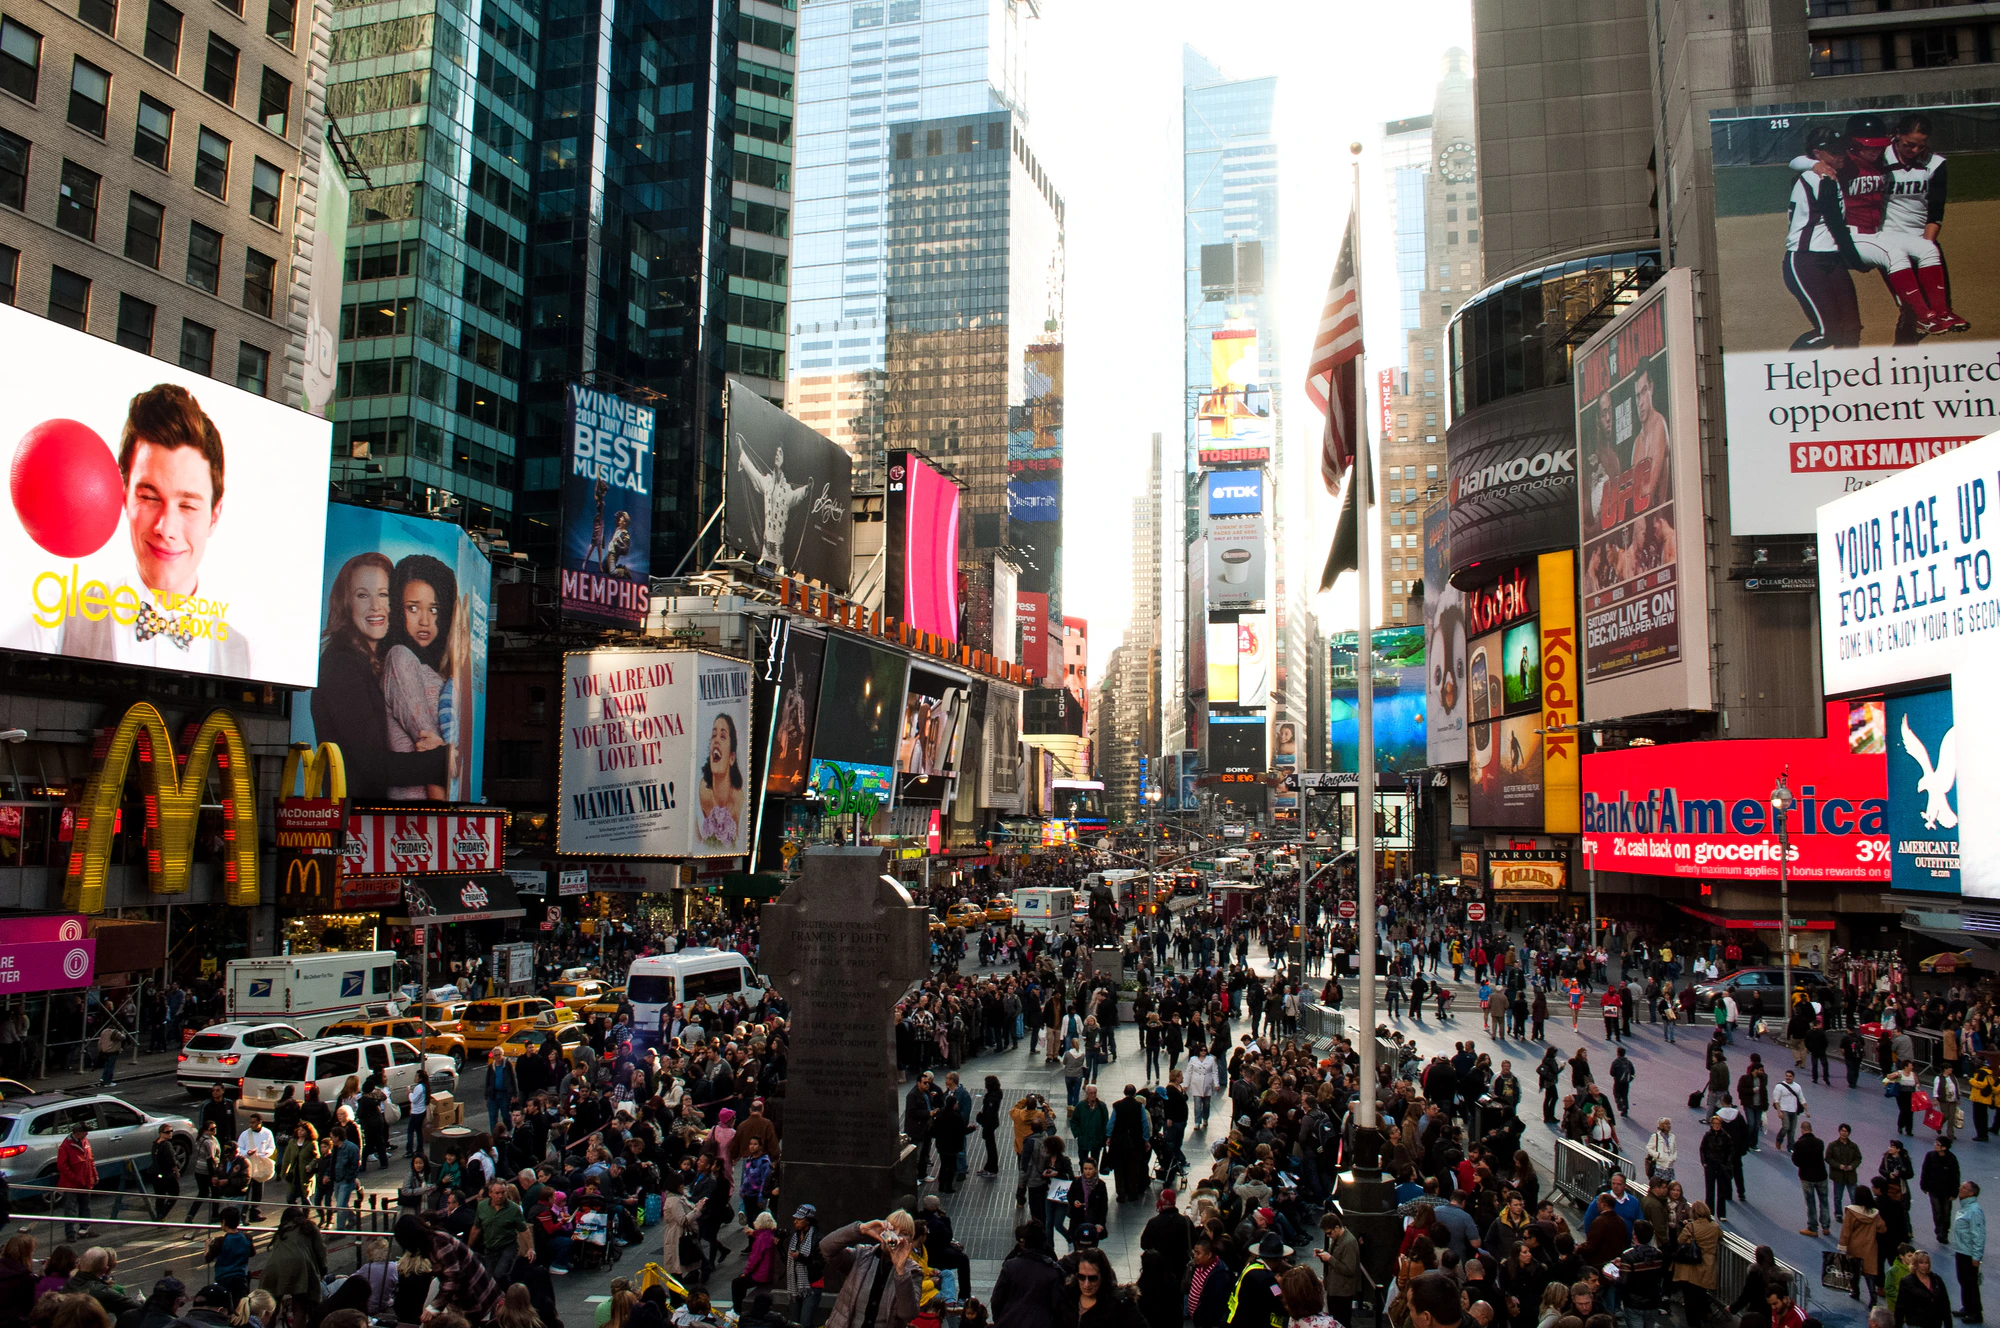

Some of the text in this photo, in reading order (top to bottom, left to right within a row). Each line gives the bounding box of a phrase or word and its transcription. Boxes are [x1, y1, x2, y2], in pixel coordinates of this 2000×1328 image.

[1770, 118, 1790, 130] 215
[1764, 352, 2000, 397] Helped injured
[572, 384, 653, 430] WINNER!
[1383, 383, 1391, 406] THE
[576, 407, 649, 443] 2010 TONY AWARD
[1769, 390, 2000, 434] opponent win.
[574, 423, 649, 475] BEST
[1200, 448, 1270, 463] TOSHIBA
[573, 456, 647, 495] MUSICAL
[889, 483, 904, 492] LG
[1470, 474, 1575, 506] driving emotion
[1223, 485, 1259, 498] TDK
[1601, 457, 1653, 530] UFC
[1835, 478, 1986, 583] YOUR FACE. UP
[32, 564, 140, 628] glee
[561, 569, 649, 612] MEMPHIS
[1470, 567, 1530, 635] Kodak
[1839, 549, 1991, 627] FOR ALL TO
[150, 589, 229, 619] TUESDAY
[1618, 599, 1648, 628] LIVE
[1651, 589, 1675, 617] ON
[178, 615, 229, 641] FOX 5
[1588, 610, 1617, 629] SATURDAY
[1619, 611, 1675, 639] PAY-PER-VIEW
[1840, 632, 1862, 660] COME
[1865, 629, 1874, 656] IN
[1888, 618, 1917, 650] ENJOY
[1921, 611, 1948, 643] YOUR
[1953, 607, 1964, 636] 15
[1588, 623, 1618, 649] DEC.10
[571, 662, 675, 699] YOU ALREADY
[698, 671, 748, 700] MAMMA MIA!
[1543, 626, 1575, 760] Kodak
[602, 691, 649, 720] KNOW
[571, 713, 685, 750] YOU'RE GONNA
[597, 741, 663, 772] LOVE IT!
[1236, 774, 1254, 782] NEWS
[276, 808, 340, 818] McDonald's
[573, 781, 676, 820] MAMMA MIA!
[1584, 786, 1889, 836] Bank of America
[1488, 851, 1567, 859] MARQUIS
[1614, 837, 1891, 864] 2% cash back on groceries 3%
[1898, 840, 1949, 854] AMERICAN
[1674, 863, 1700, 876] Quarterly
[1701, 865, 1742, 875] maximum
[1744, 865, 1778, 877] applies
[1793, 865, 1823, 876] bonus
[1825, 865, 1866, 877] rewards
[1868, 868, 1881, 877] on
[1884, 868, 1891, 878] g
[1915, 857, 1961, 869] OUTFITTER
[1930, 869, 1951, 878] ae.com
[1501, 868, 1554, 888] FOLLIES
[791, 931, 837, 942] FRANCIS
[851, 933, 890, 943] DUFFY
[0, 956, 15, 968] RE
[0, 970, 20, 983] TER
